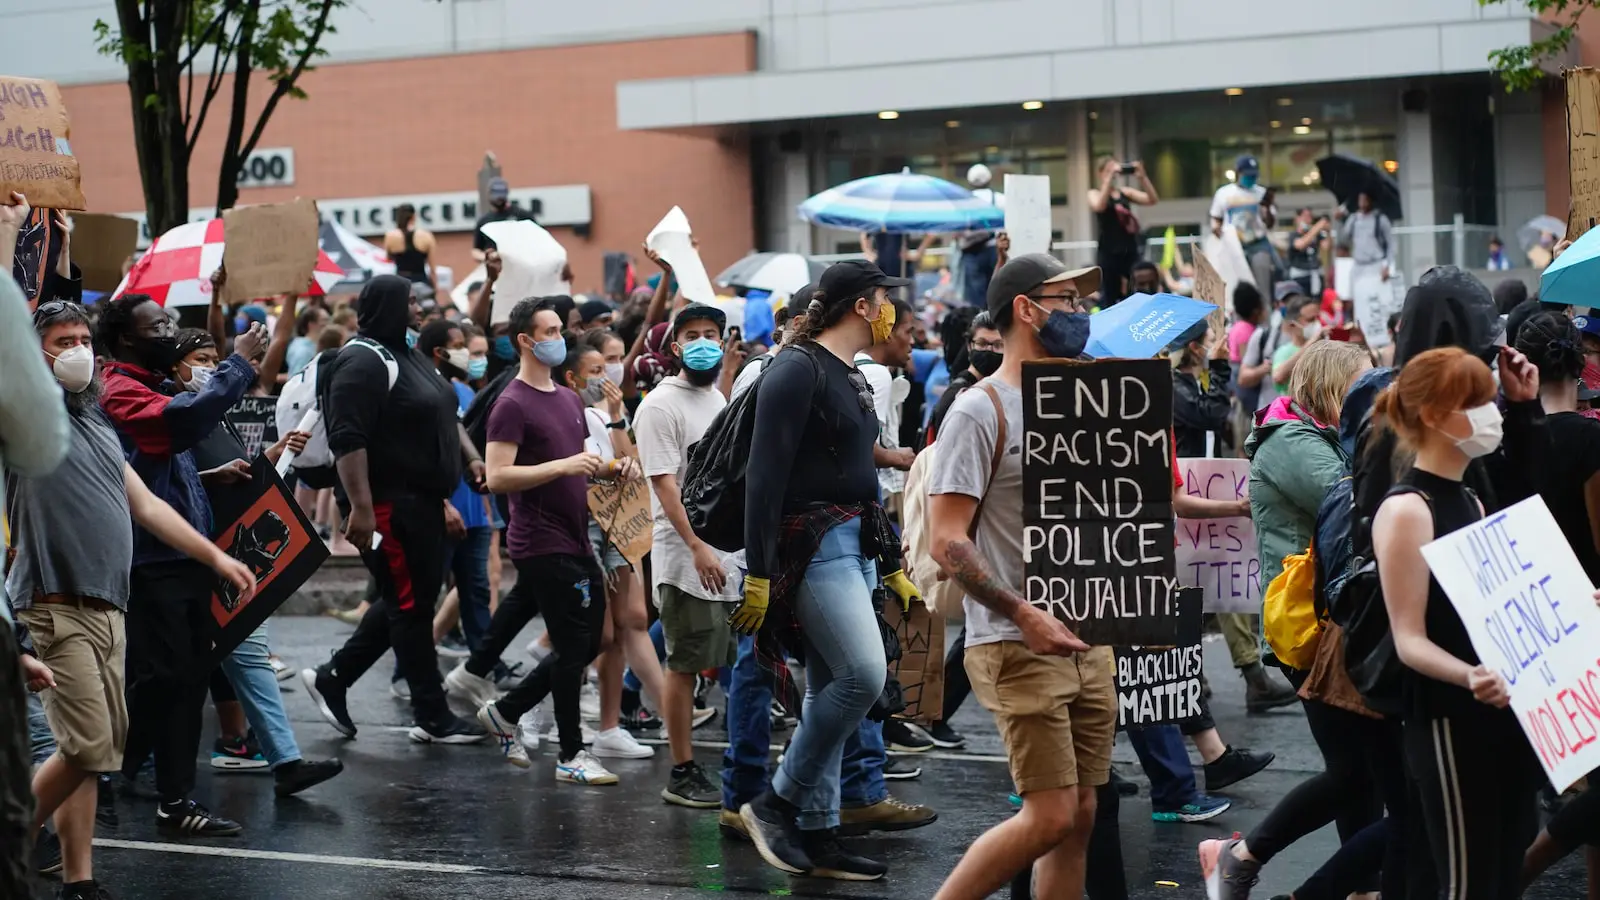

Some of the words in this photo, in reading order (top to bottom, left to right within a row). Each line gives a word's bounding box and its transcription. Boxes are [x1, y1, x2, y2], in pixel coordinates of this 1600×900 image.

[1036, 376, 1150, 420] END
[1025, 428, 1169, 468] RACISM
[1040, 478, 1143, 519] END
[1187, 468, 1246, 501] ACK
[1023, 522, 1164, 566] POLICE
[1184, 524, 1242, 552] VES
[1456, 513, 1534, 599] WHITE
[1026, 576, 1177, 621] BRUTALITY
[1187, 558, 1261, 600] TTER
[1485, 574, 1579, 686] SILENCE
[1118, 654, 1163, 688] BLACK
[1164, 643, 1202, 681] LIVES
[1118, 678, 1202, 726] MATTER
[1526, 658, 1600, 772] VIOLENC
